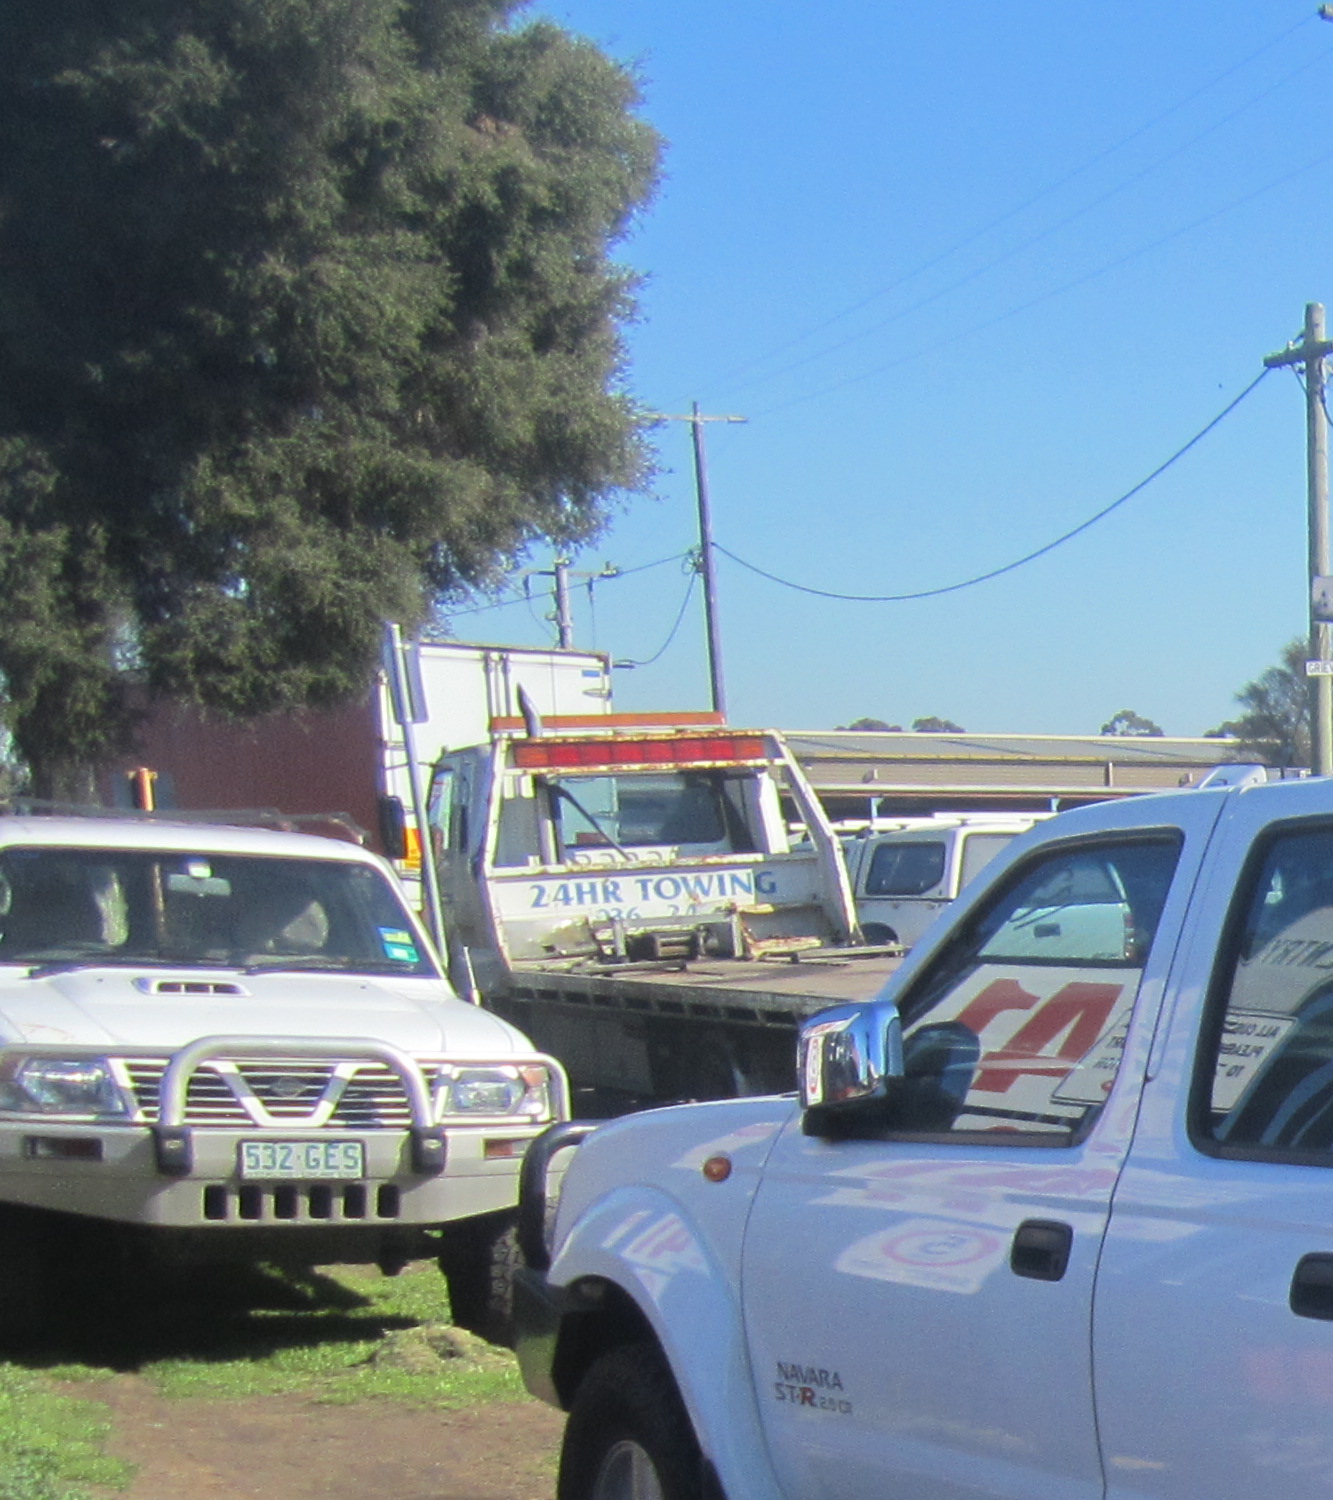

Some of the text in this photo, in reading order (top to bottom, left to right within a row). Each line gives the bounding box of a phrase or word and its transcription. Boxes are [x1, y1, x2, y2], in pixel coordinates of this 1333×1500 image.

[530, 871, 778, 909] 24HR TOWING
[775, 1362, 844, 1391] NAVARA
